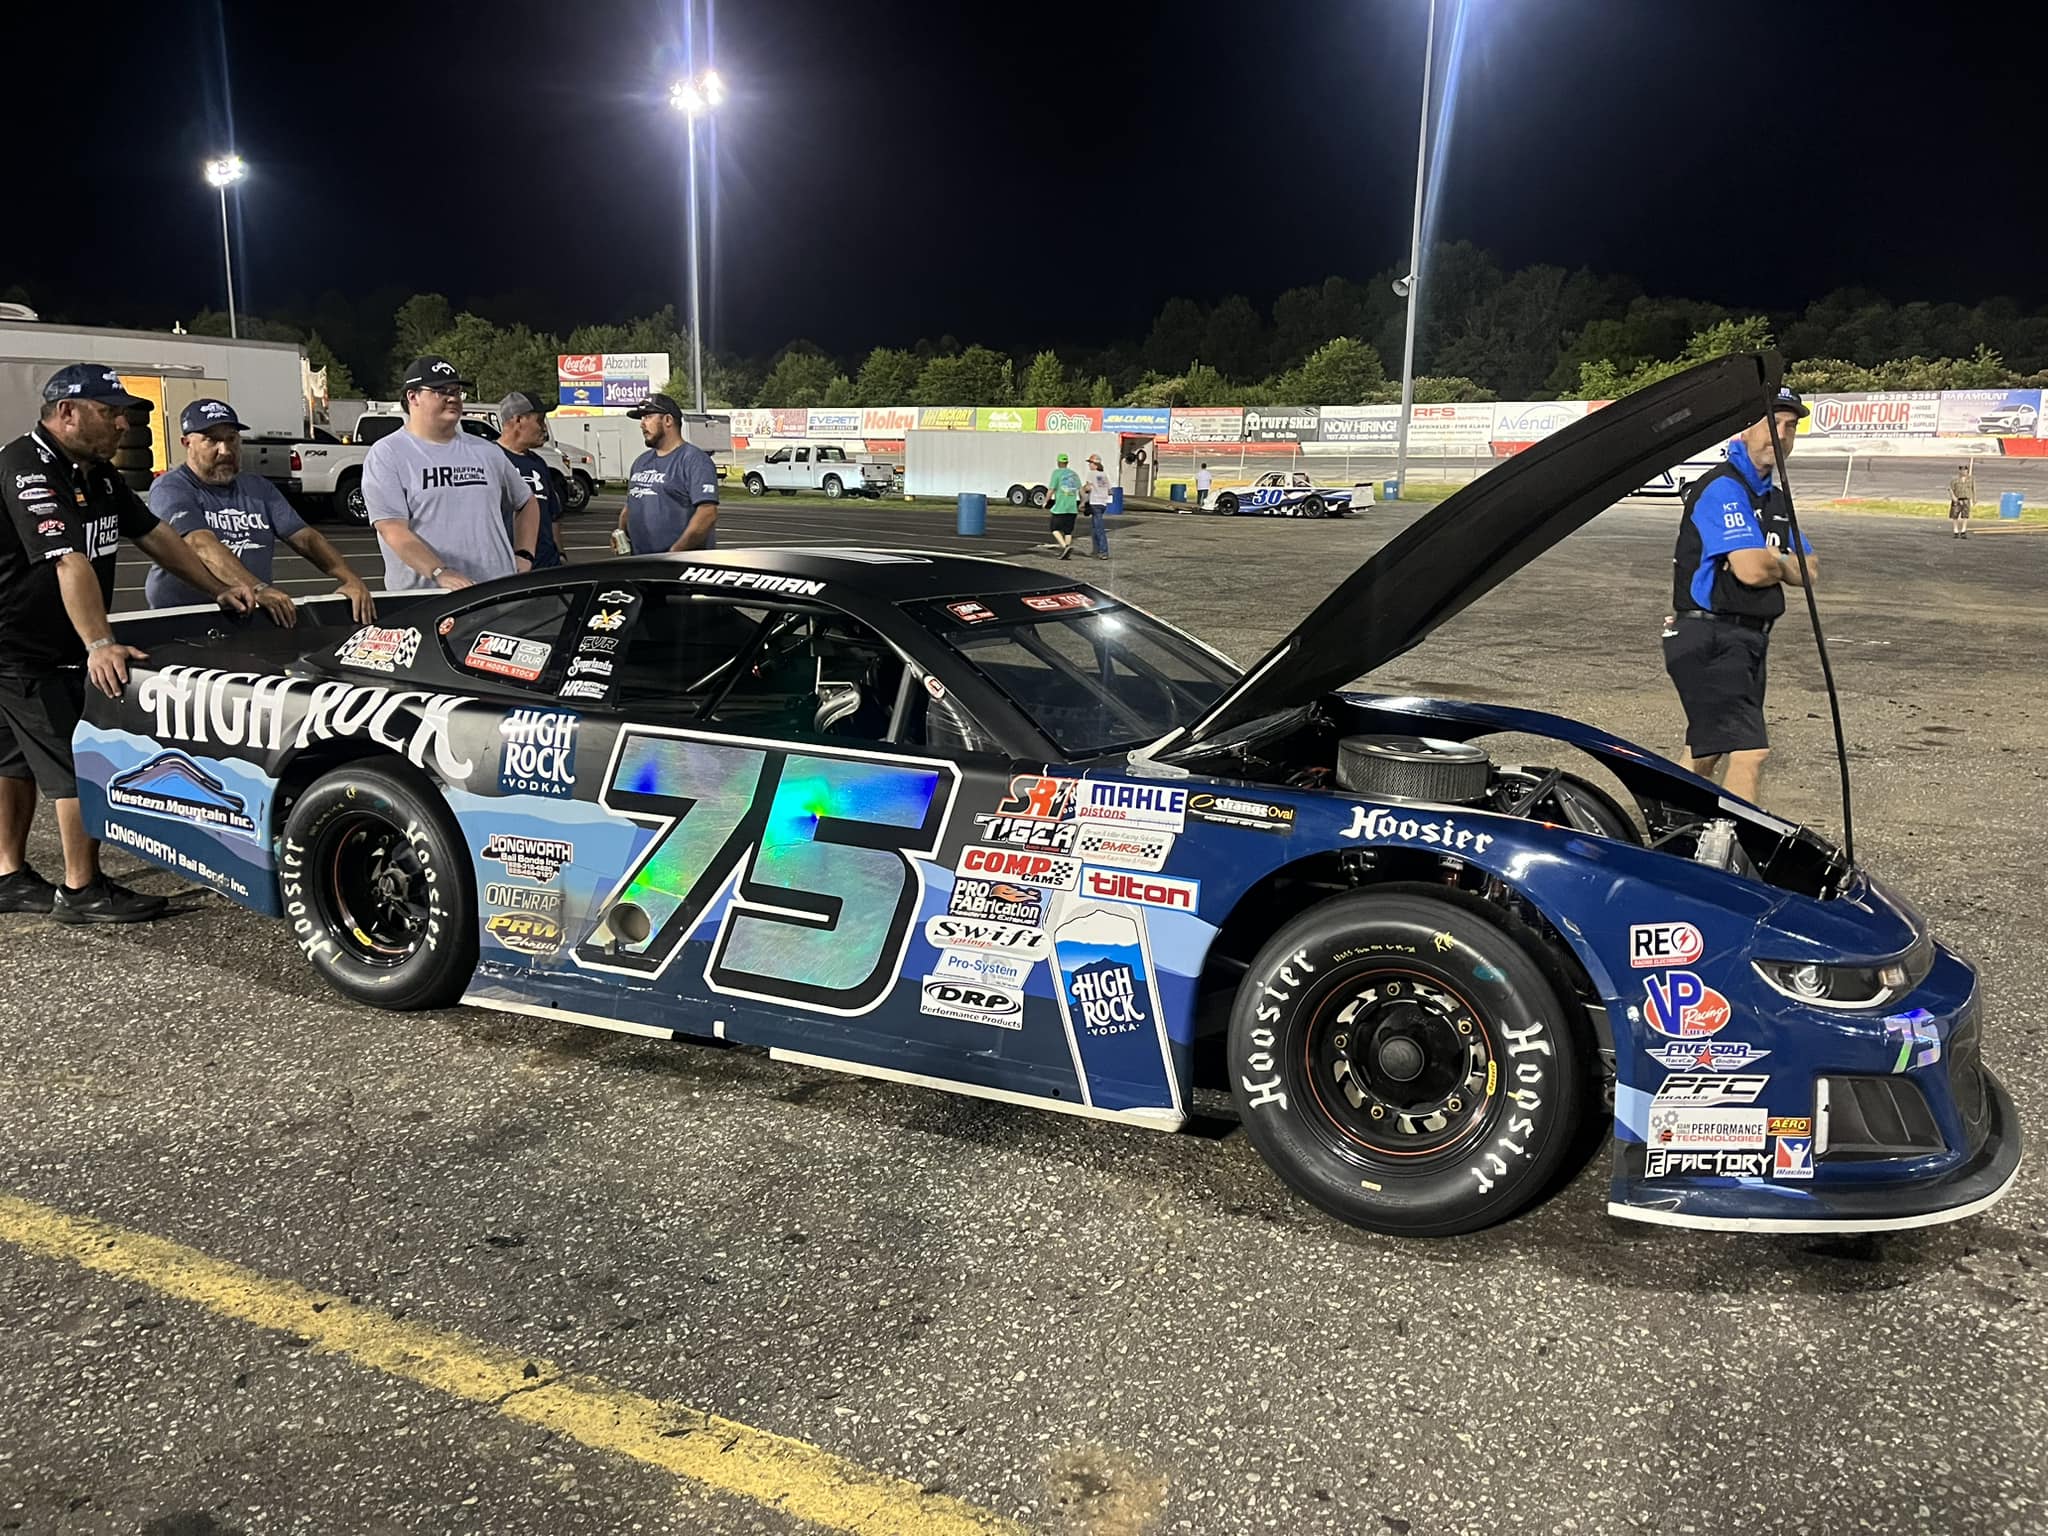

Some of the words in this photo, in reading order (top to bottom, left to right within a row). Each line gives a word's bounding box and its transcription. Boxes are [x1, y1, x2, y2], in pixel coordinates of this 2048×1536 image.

[604, 356, 648, 369] Abzorbit
[606, 382, 649, 400] Hoosier
[1943, 392, 2009, 400] PARAMOUNT
[809, 416, 860, 424] EVERETT
[864, 410, 914, 430] Holley
[1047, 413, 1090, 431] O'Reilly
[1260, 417, 1289, 429] TUFF
[1289, 416, 1318, 429] SHED
[1413, 407, 1456, 417] RFS
[1842, 403, 1911, 423] UNIFOUR
[1323, 421, 1356, 433] NOW
[1354, 420, 1398, 433] HIRING!
[422, 466, 453, 490] HR
[1252, 488, 1285, 506] 30
[233, 512, 270, 531] ROCK
[1723, 512, 1746, 528] 88
[679, 567, 827, 596] HUFFMAN
[516, 653, 542, 666] TOUR
[511, 667, 536, 679] STOCK
[138, 665, 304, 751] HIGH
[293, 682, 480, 779] ROCK
[499, 708, 580, 750] HIGH
[503, 742, 576, 785] ROCK
[111, 788, 166, 811] Western
[166, 799, 227, 824] Mountain
[229, 811, 255, 829] Inc.
[1091, 783, 1185, 813] MAHLE
[1078, 806, 1127, 820] pistons
[974, 813, 1077, 849] TIGER
[1339, 805, 1495, 854] Hoosier
[104, 819, 177, 866] LONGWORTH
[178, 852, 198, 873] Bail
[230, 878, 250, 897] Inc.
[490, 834, 572, 862] LONGWORTH
[500, 852, 517, 862] Bail
[1100, 841, 1141, 854] BMRS
[568, 722, 964, 1017] 75
[964, 849, 1052, 875] COMP
[403, 820, 449, 952] Hoosier
[955, 879, 990, 898] PRO
[1021, 873, 1065, 887] CAMS
[1088, 872, 1191, 908] tilton
[280, 837, 333, 962] Hoosier
[949, 895, 1040, 921] FABrication
[486, 915, 559, 938] PRW
[948, 936, 993, 948] springs
[948, 955, 1018, 978] Pro-System
[1071, 966, 1135, 1001] HIGH
[937, 985, 1010, 1009] DRP
[1643, 970, 1705, 1037] VP
[921, 1004, 980, 1021] Performance
[981, 1014, 1022, 1030] Products
[1080, 993, 1146, 1029] ROCK
[1683, 1005, 1731, 1030] Racing
[1241, 948, 1316, 1112] Hoosier
[1883, 1007, 1942, 1075] 75
[1666, 1044, 1704, 1057] FIVE
[1709, 1044, 1750, 1057] STAR
[1660, 1076, 1766, 1095] PFC
[1470, 1021, 1552, 1195] Hoosier
[1691, 1123, 1763, 1136] PERFORMANCE
[1770, 1119, 1808, 1130] AERO
[1676, 1135, 1763, 1143] TECHNOLOGIES
[1666, 1150, 1774, 1177] FACTORY
